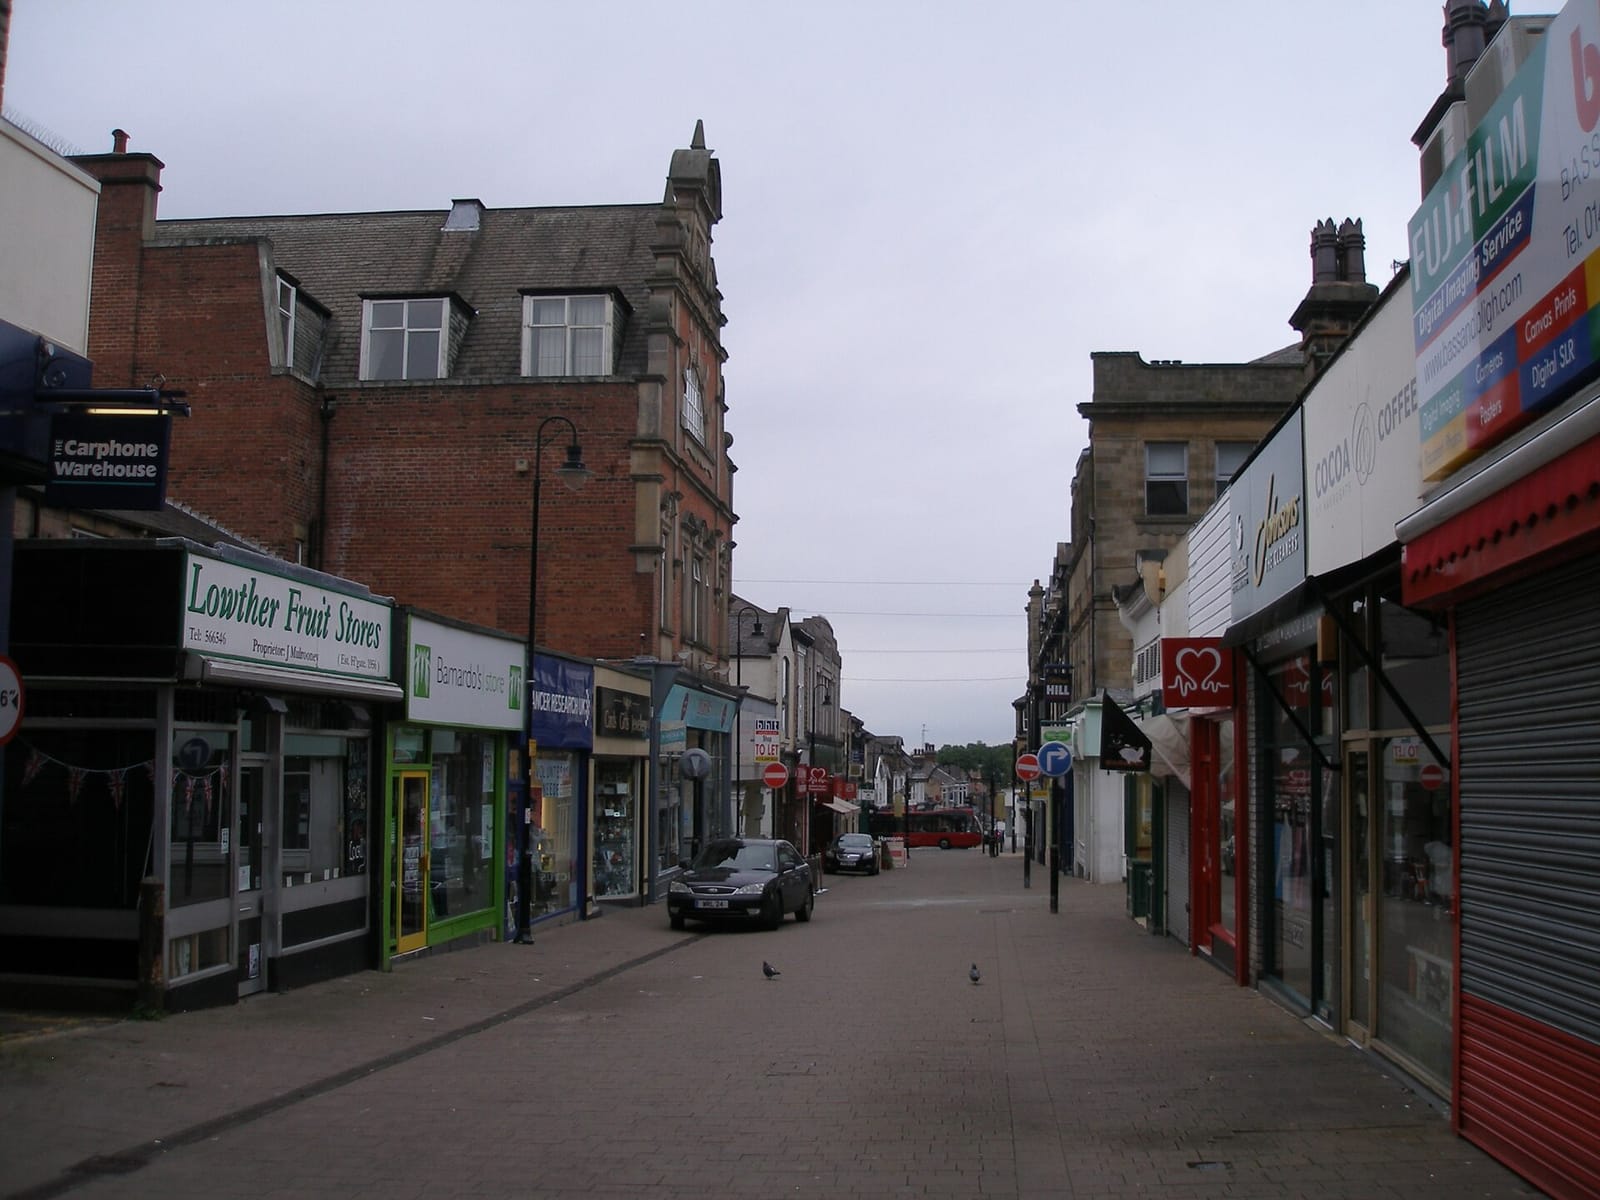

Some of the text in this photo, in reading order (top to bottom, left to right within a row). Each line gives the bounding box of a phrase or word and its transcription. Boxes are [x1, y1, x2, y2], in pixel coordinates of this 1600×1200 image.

[1563, 218, 1582, 258] Tel.
[1419, 210, 1523, 337] Digital Imaging Service
[1524, 287, 1577, 344] Canvas Prints
[1475, 351, 1504, 384] Cameras
[1531, 338, 1576, 389] Digital SLR
[64, 439, 159, 460] Carphone
[1314, 437, 1350, 499] COCOA
[1377, 376, 1418, 442] COFFEE
[54, 460, 158, 478] Warehouse
[187, 562, 382, 649] Lowther Fruit Stores
[437, 655, 482, 690] Barnardo's
[1046, 685, 1070, 695] HILL
[551, 693, 579, 714] RESEARCH
[756, 744, 779, 756] TO LET
